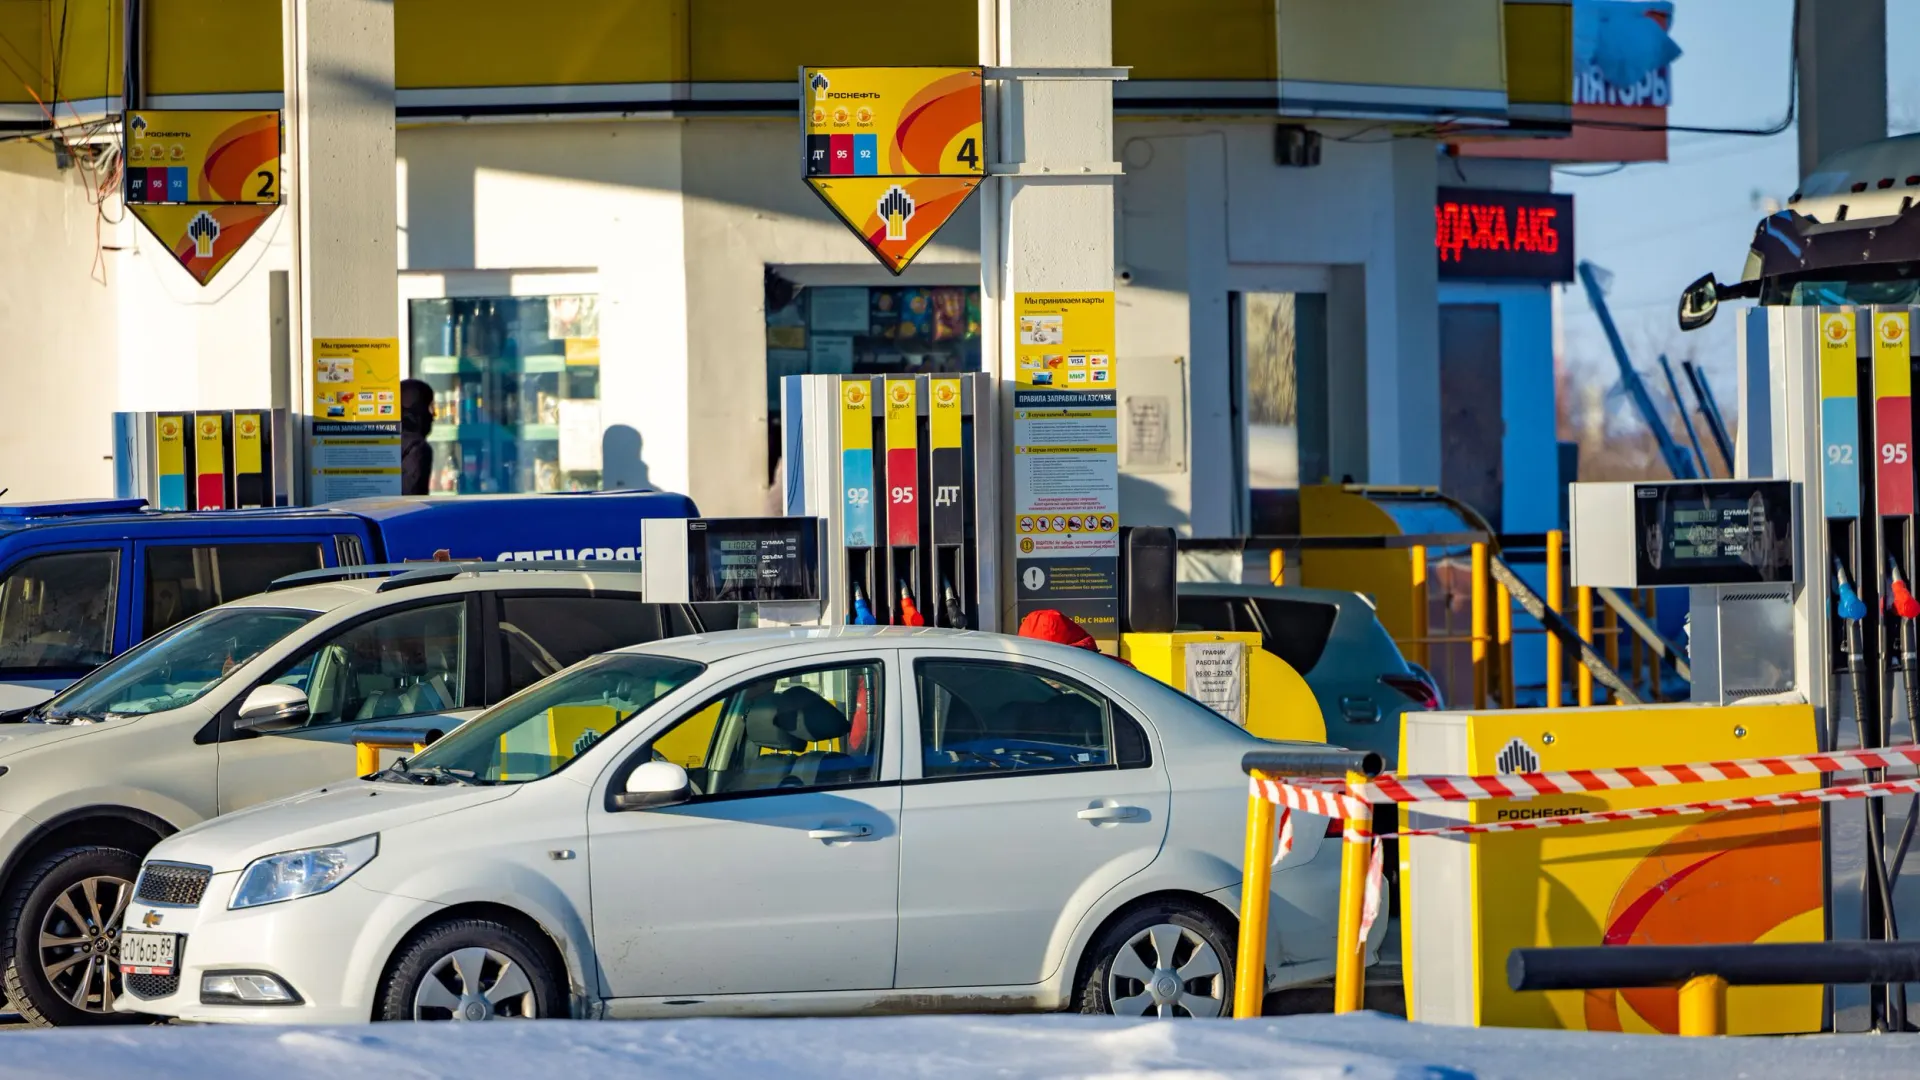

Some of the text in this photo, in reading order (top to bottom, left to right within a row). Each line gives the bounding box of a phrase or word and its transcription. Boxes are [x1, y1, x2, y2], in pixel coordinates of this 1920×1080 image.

[812, 150, 871, 160] ДТ 95 92
[956, 138, 978, 169] 4
[132, 180, 183, 189] ДТ 95 92
[257, 171, 275, 198] 2
[1514, 206, 1559, 254] АКБ
[1827, 444, 1854, 465] 92
[1881, 443, 1908, 465] 95
[847, 488, 869, 504] 92
[891, 487, 914, 504] 95
[935, 486, 960, 506] ДТ
[1498, 808, 1590, 820] РОСНЕФТЬ
[160, 938, 171, 956] 89
